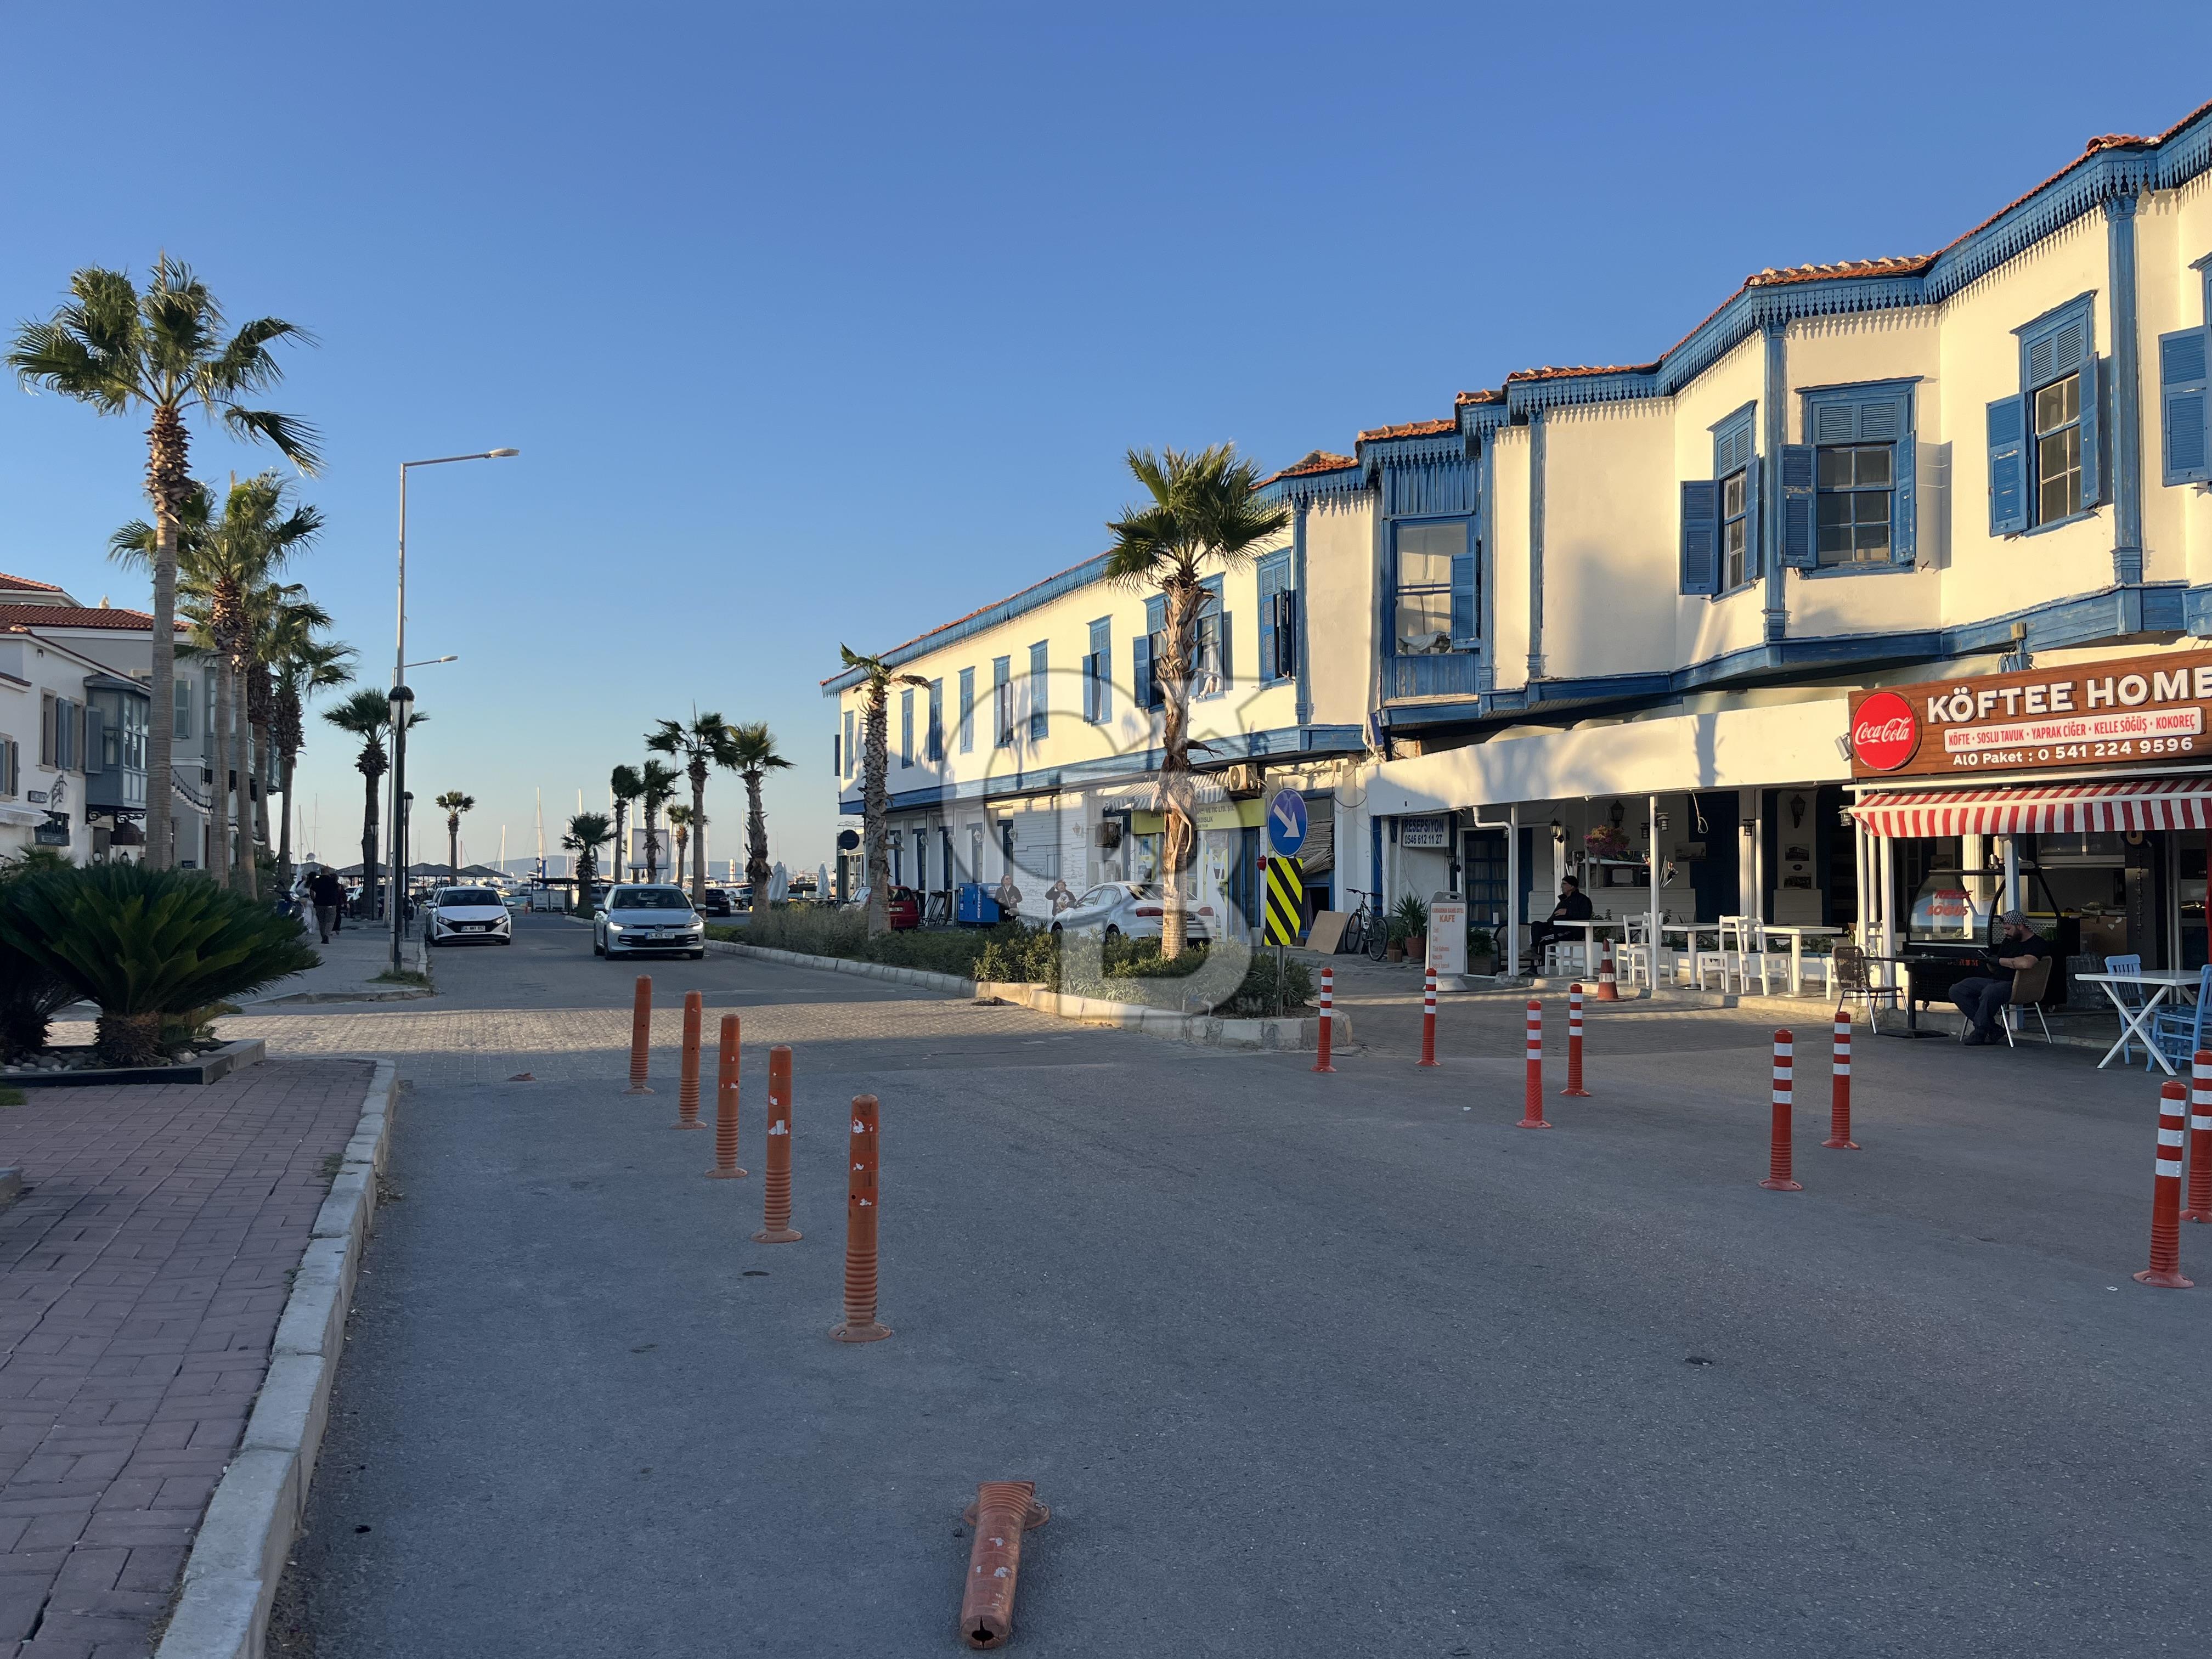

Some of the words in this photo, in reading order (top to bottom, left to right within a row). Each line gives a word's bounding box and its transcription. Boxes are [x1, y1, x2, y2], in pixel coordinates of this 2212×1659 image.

[1927, 682, 2074, 723] KÖFTEE
[2087, 666, 2212, 708] HOME
[1855, 717, 1912, 746] Coca-Cola
[1949, 731, 1970, 746] KÖFTE
[1977, 731, 1999, 744] SOSLU
[2000, 729, 2024, 742] TAVUK
[2032, 726, 2062, 740] YAPRAK
[2063, 720, 2086, 737] CİĞER
[2094, 721, 2119, 735] KELLE
[2120, 716, 2147, 734] SÖĞÜŞ
[2156, 714, 2196, 731] KOKOREÇ
[1983, 751, 2023, 764] Paket
[2055, 744, 2086, 759] 541
[2094, 741, 2132, 757] 224
[2139, 737, 2193, 754] 9596
[1404, 834, 1417, 844] 0546
[1418, 834, 1427, 844] 612
[1429, 834, 1434, 844] 11
[1436, 834, 1442, 844] 27
